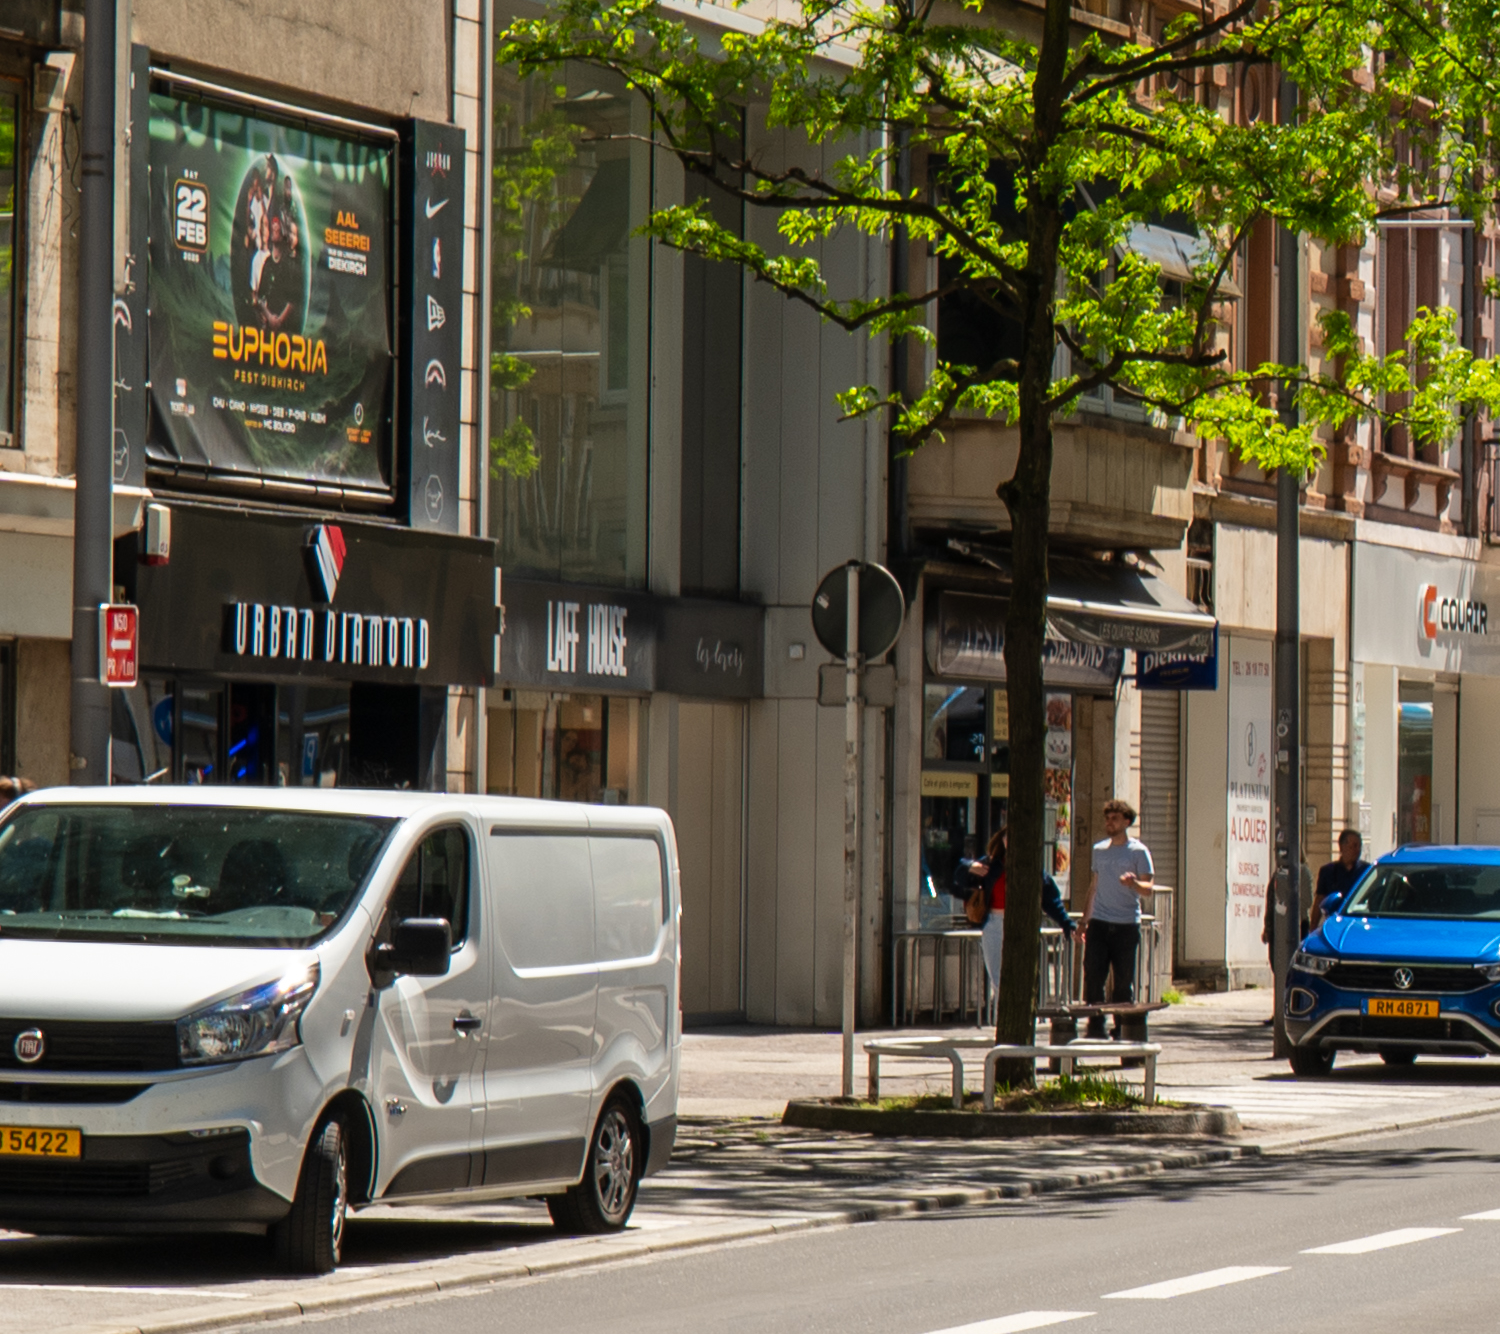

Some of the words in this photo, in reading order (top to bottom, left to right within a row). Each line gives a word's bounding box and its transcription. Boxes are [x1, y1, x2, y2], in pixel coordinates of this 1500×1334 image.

[177, 186, 207, 223] 22
[336, 210, 359, 229] AAL
[176, 219, 207, 245] FEB
[213, 320, 328, 376] EUPHORIA
[261, 373, 306, 392] DIEKIRCH
[113, 613, 128, 631] N50
[1441, 598, 1488, 635] COURIR
[236, 602, 314, 661] URBAN
[326, 609, 430, 669] DIAMOND
[547, 600, 580, 673] LAFF
[587, 603, 628, 677] HOUSE
[107, 658, 116, 676] PR
[1231, 781, 1270, 801] PLATINIUM
[1238, 817, 1268, 845] LOUER
[1238, 860, 1260, 877] SURFACE
[1232, 881, 1265, 898] COMMERCIALE
[1375, 1001, 1395, 1015] RM
[1396, 1002, 1430, 1017] 4871
[21, 1039, 38, 1054] FIAT
[10, 1130, 68, 1153] 5422
